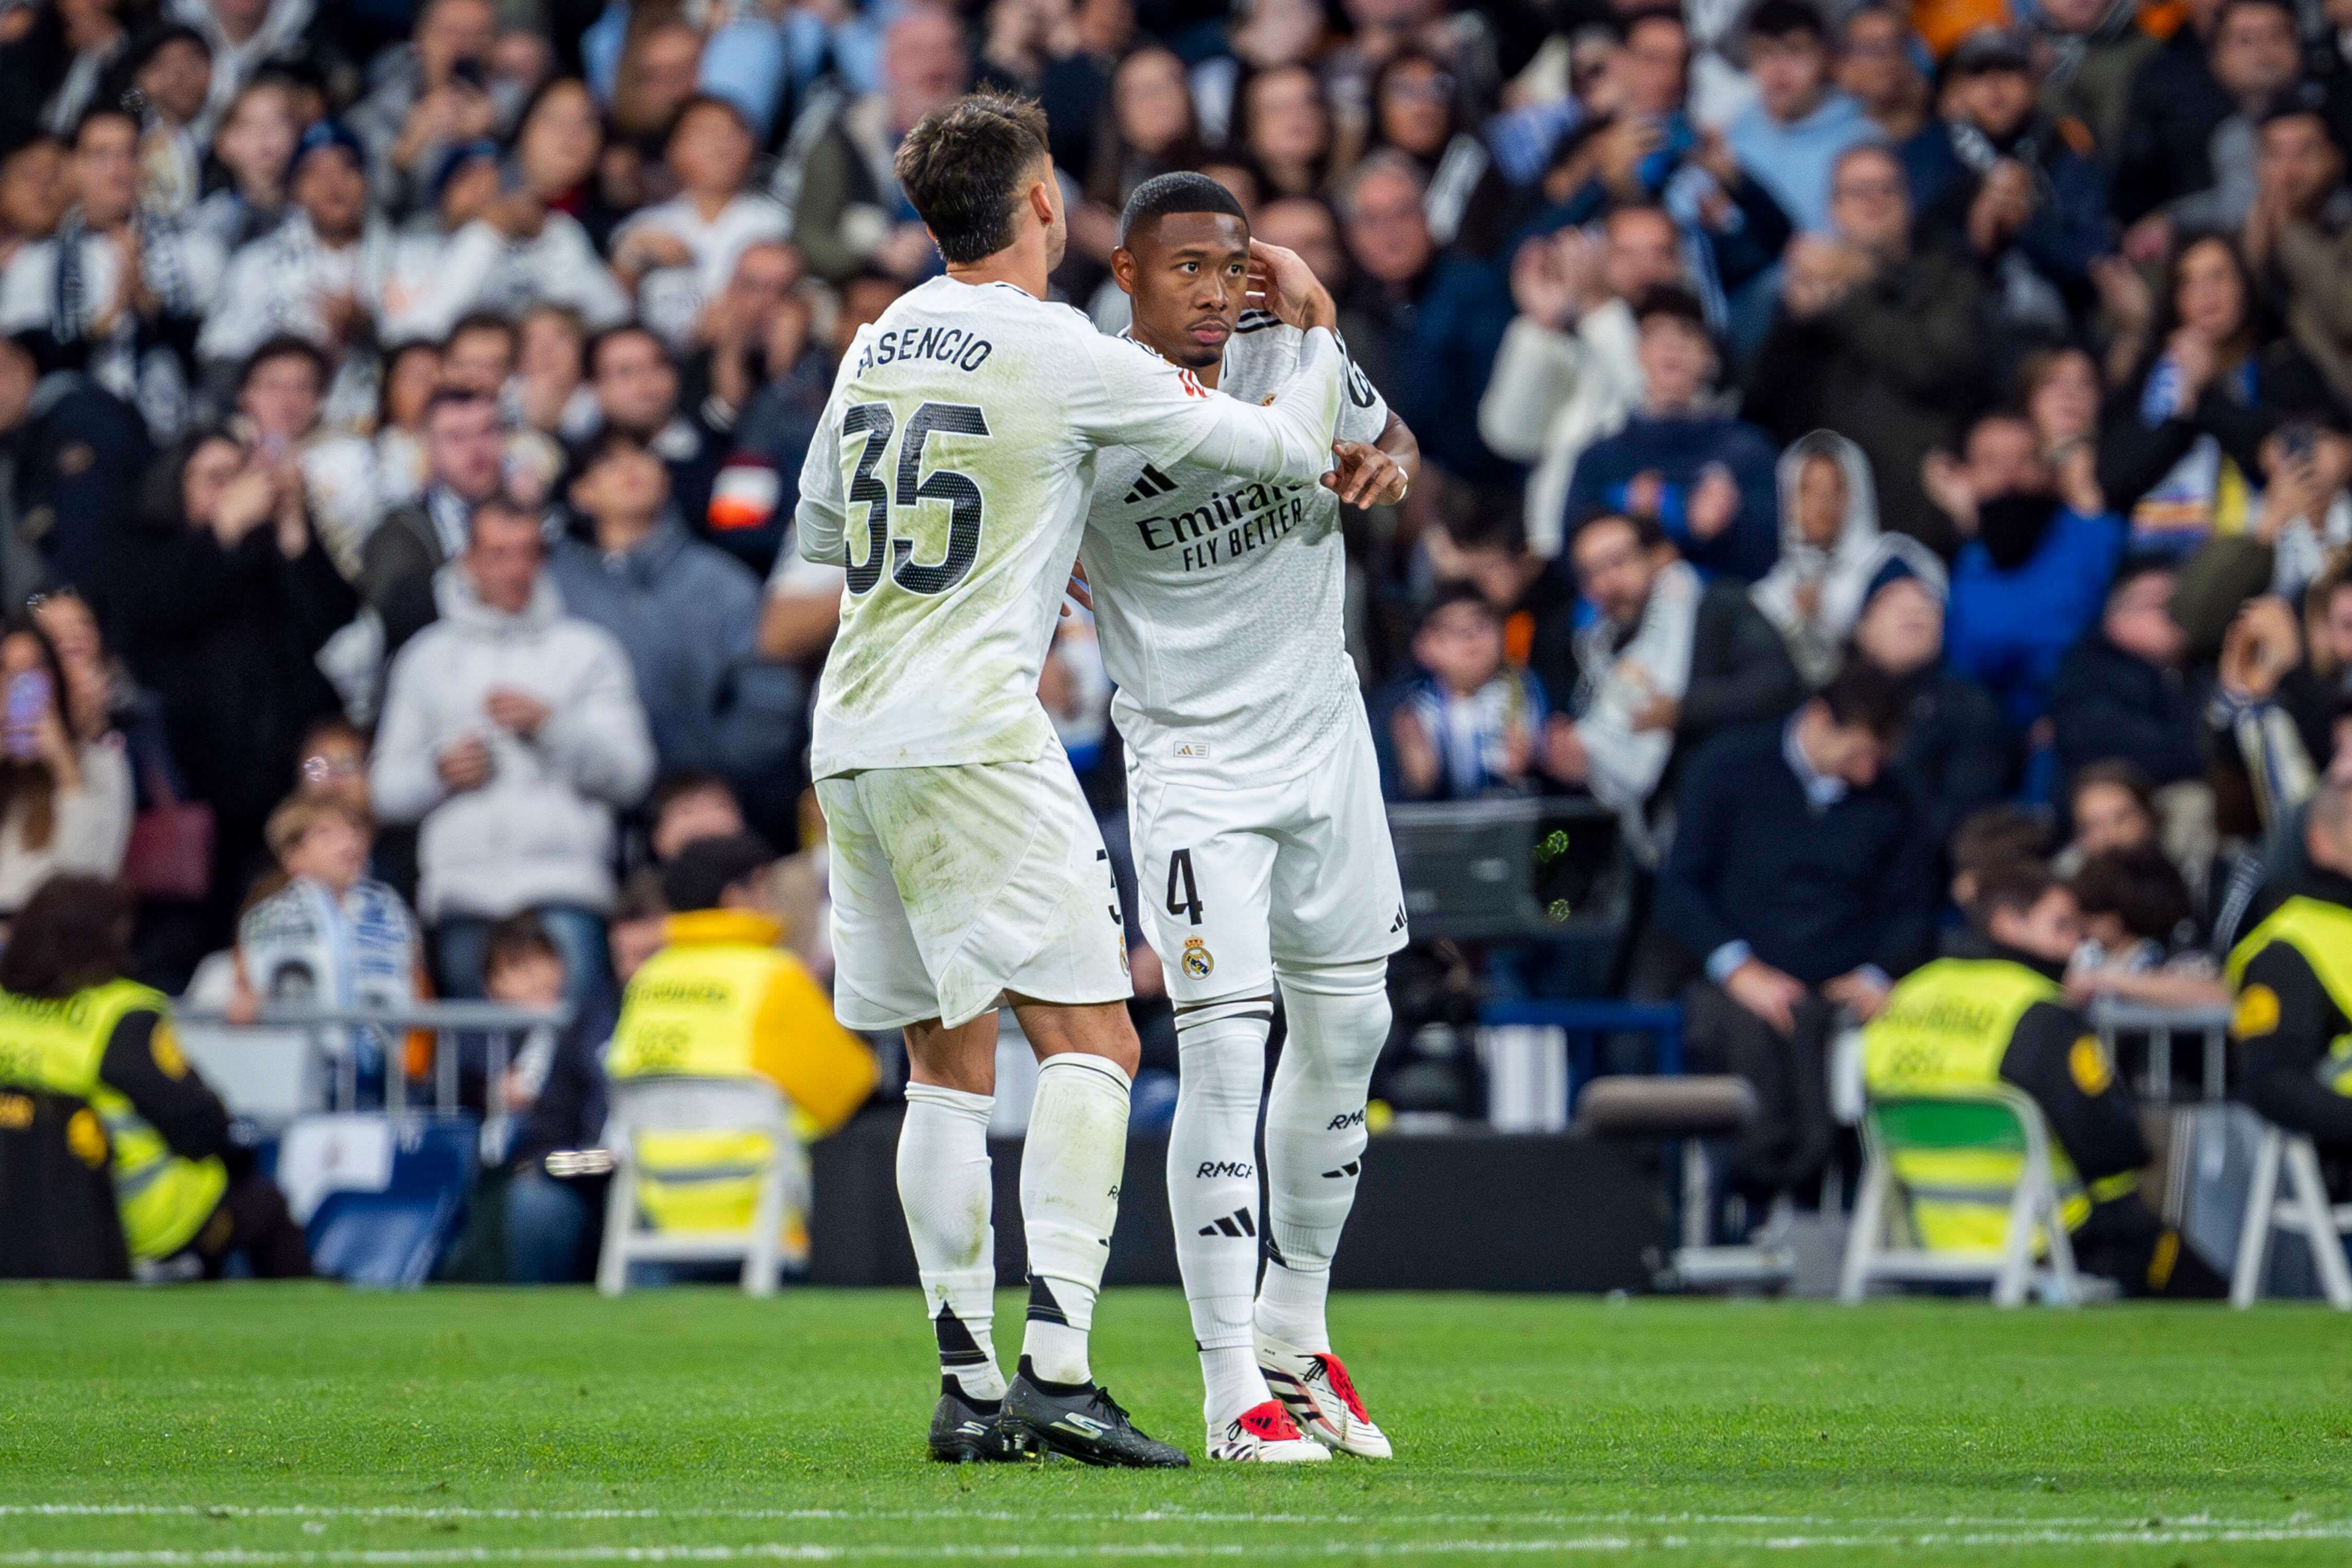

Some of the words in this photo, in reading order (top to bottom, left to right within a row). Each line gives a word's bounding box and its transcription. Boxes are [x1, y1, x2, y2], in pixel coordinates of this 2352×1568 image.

[856, 327, 991, 378] ASENCIO
[842, 401, 990, 594] 35
[1183, 537, 1218, 572] FLY
[1229, 497, 1302, 557] BETTER
[1166, 848, 1204, 926] 4
